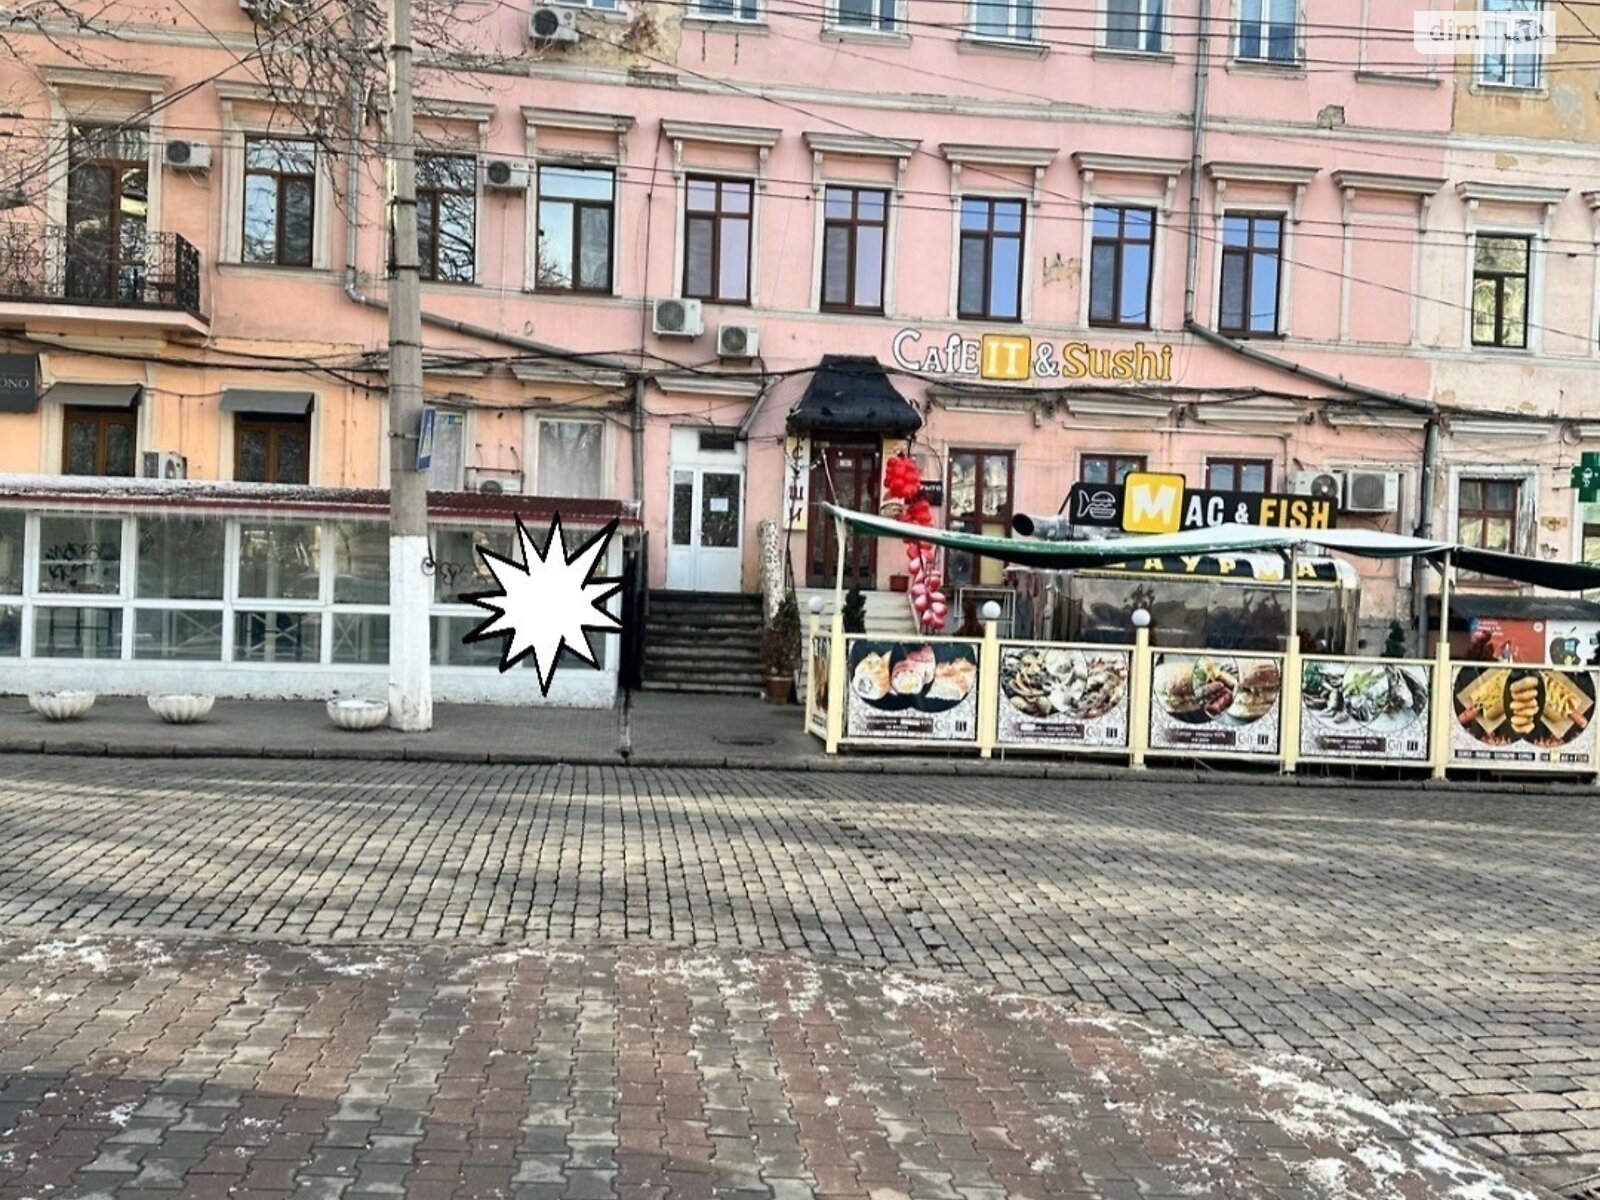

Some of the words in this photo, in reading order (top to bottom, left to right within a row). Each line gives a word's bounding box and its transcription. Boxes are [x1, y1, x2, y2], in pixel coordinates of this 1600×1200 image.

[985, 339, 1026, 375] IT
[1035, 342, 1059, 377] &
[1062, 342, 1173, 381] Sushi
[1234, 502, 1249, 524] &
[1259, 498, 1330, 530] FISH
